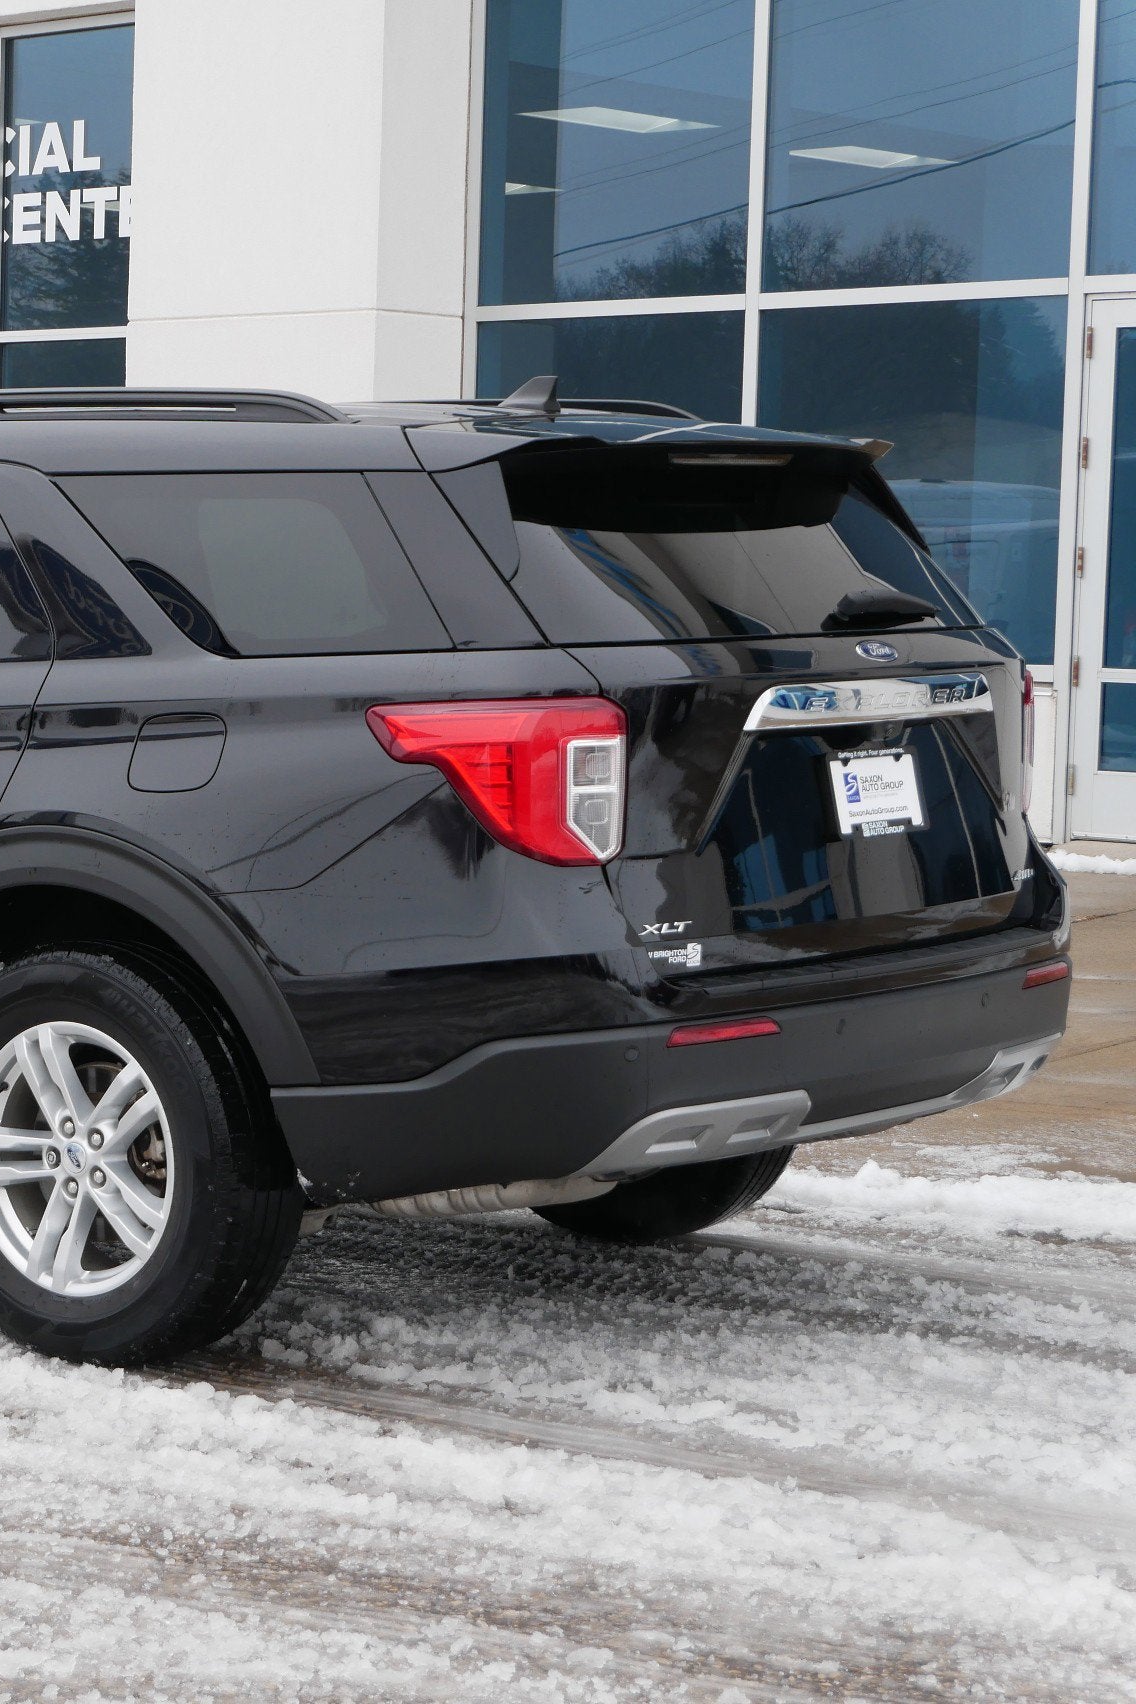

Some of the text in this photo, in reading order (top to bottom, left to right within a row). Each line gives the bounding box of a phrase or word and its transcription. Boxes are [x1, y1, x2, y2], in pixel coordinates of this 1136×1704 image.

[804, 687, 966, 713] EXPLORER
[859, 774, 883, 784] SAXON
[861, 780, 904, 792] AUTO GROUP
[848, 804, 909, 818] SaxonAutoGroup.com
[885, 825, 905, 835] GROUP
[638, 920, 693, 936] XLT
[653, 948, 687, 959] BRIGHTON
[668, 956, 687, 964] FORD
